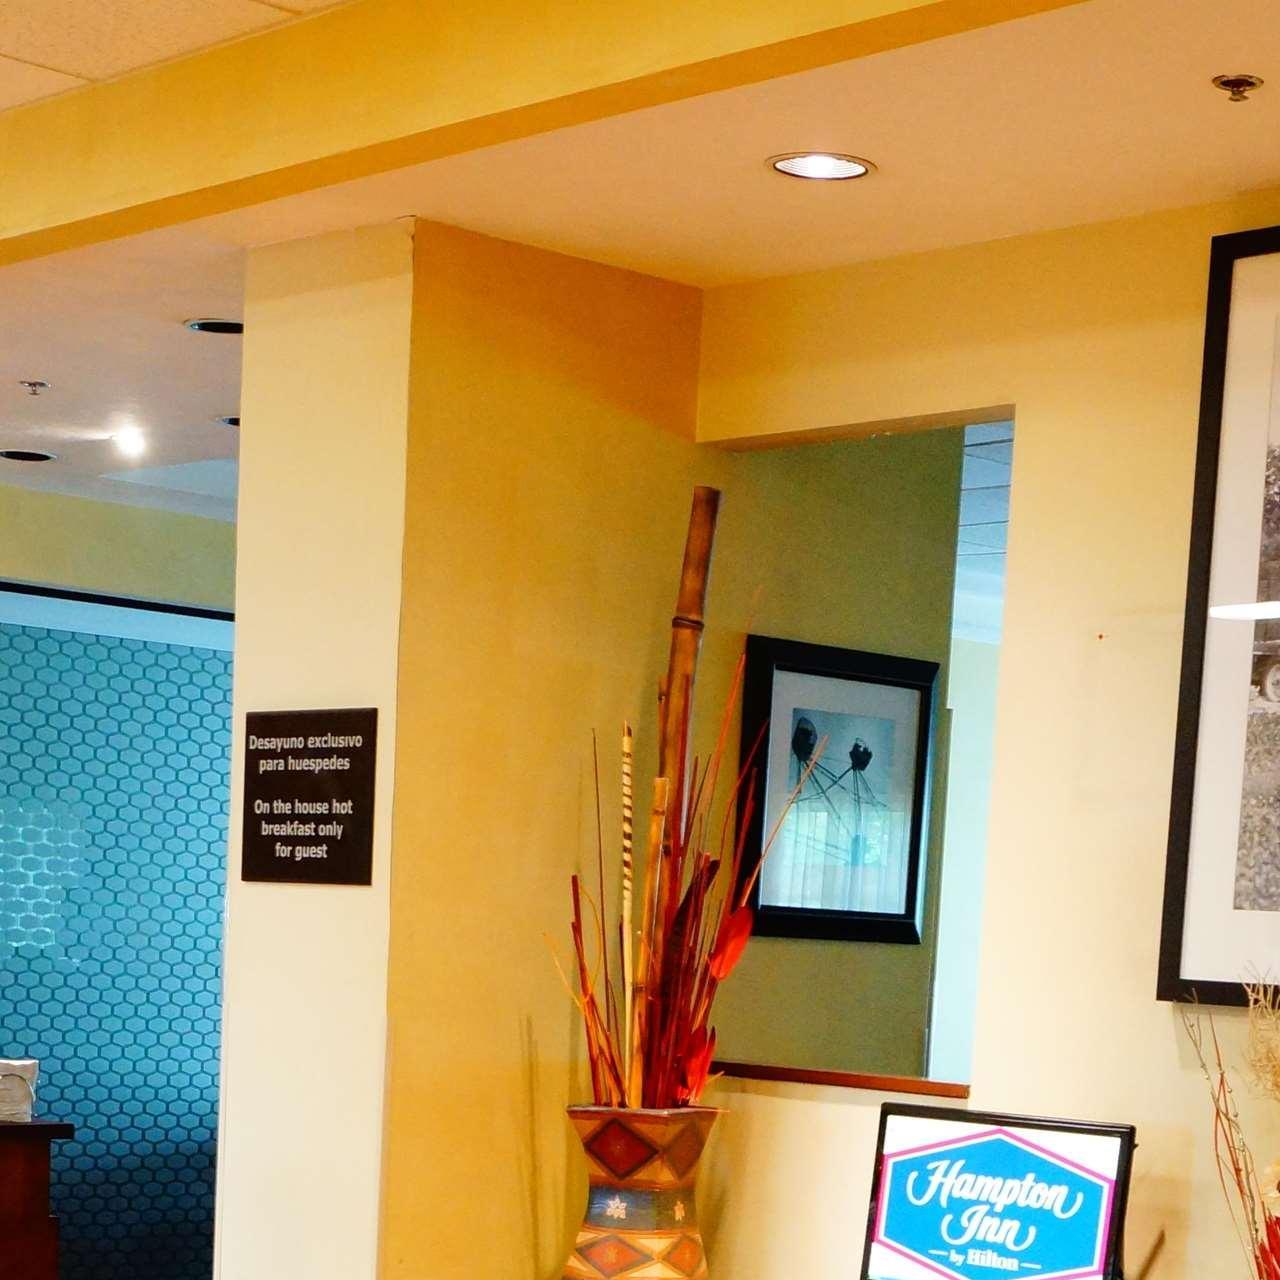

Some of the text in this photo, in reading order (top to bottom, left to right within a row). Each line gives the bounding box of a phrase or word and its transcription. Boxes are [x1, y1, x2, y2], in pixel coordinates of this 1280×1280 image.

[248, 732, 363, 753] Desayuno exclusivo
[259, 754, 351, 774] para huespedes
[253, 798, 353, 814] On the house hot
[261, 820, 344, 840] breakfast only
[275, 842, 328, 861] for guest
[906, 1159, 1084, 1220] Hampton
[940, 1204, 1037, 1252] Inn
[948, 1248, 1020, 1272] by Hilton
